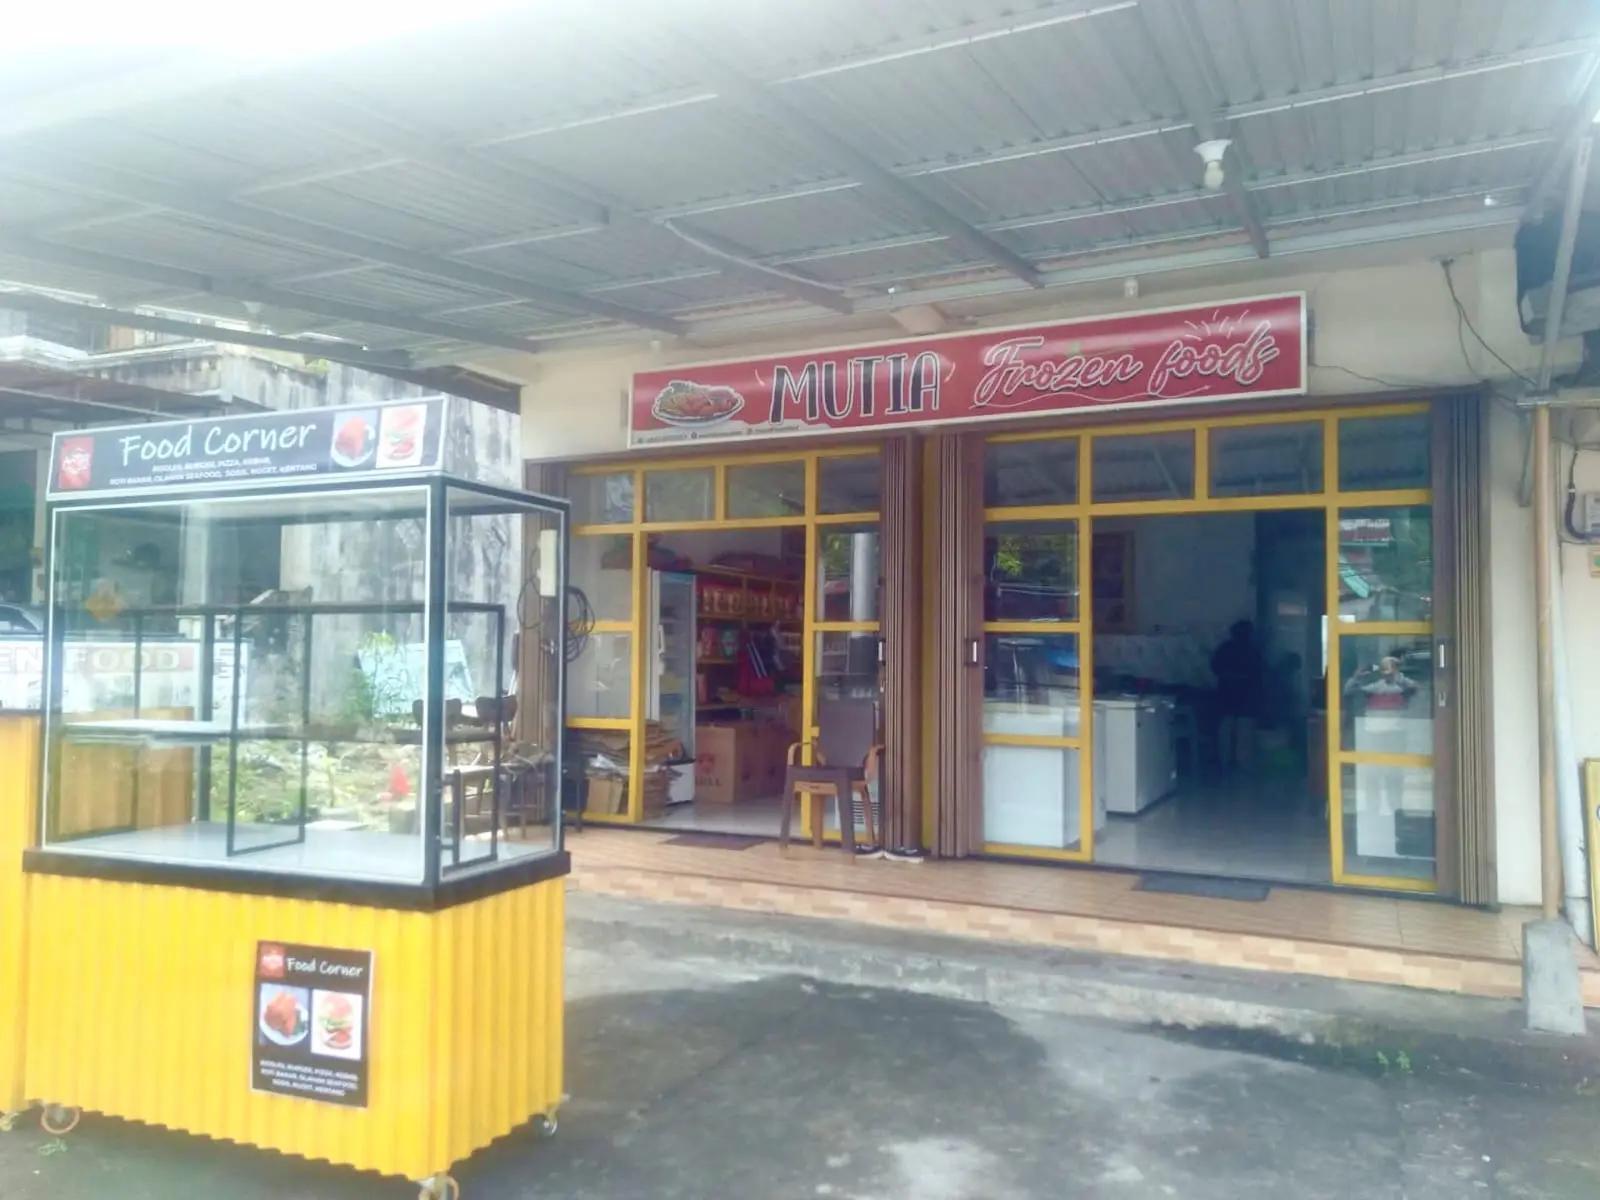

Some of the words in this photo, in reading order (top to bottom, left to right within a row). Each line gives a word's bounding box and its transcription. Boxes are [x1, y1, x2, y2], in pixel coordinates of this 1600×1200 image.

[769, 351, 941, 425] MUTIA
[971, 336, 1144, 406] Frozen
[1149, 318, 1281, 398] foods
[119, 425, 192, 466] Food
[204, 424, 317, 455] Corner
[287, 957, 316, 972] Food
[319, 960, 364, 977] Corner
